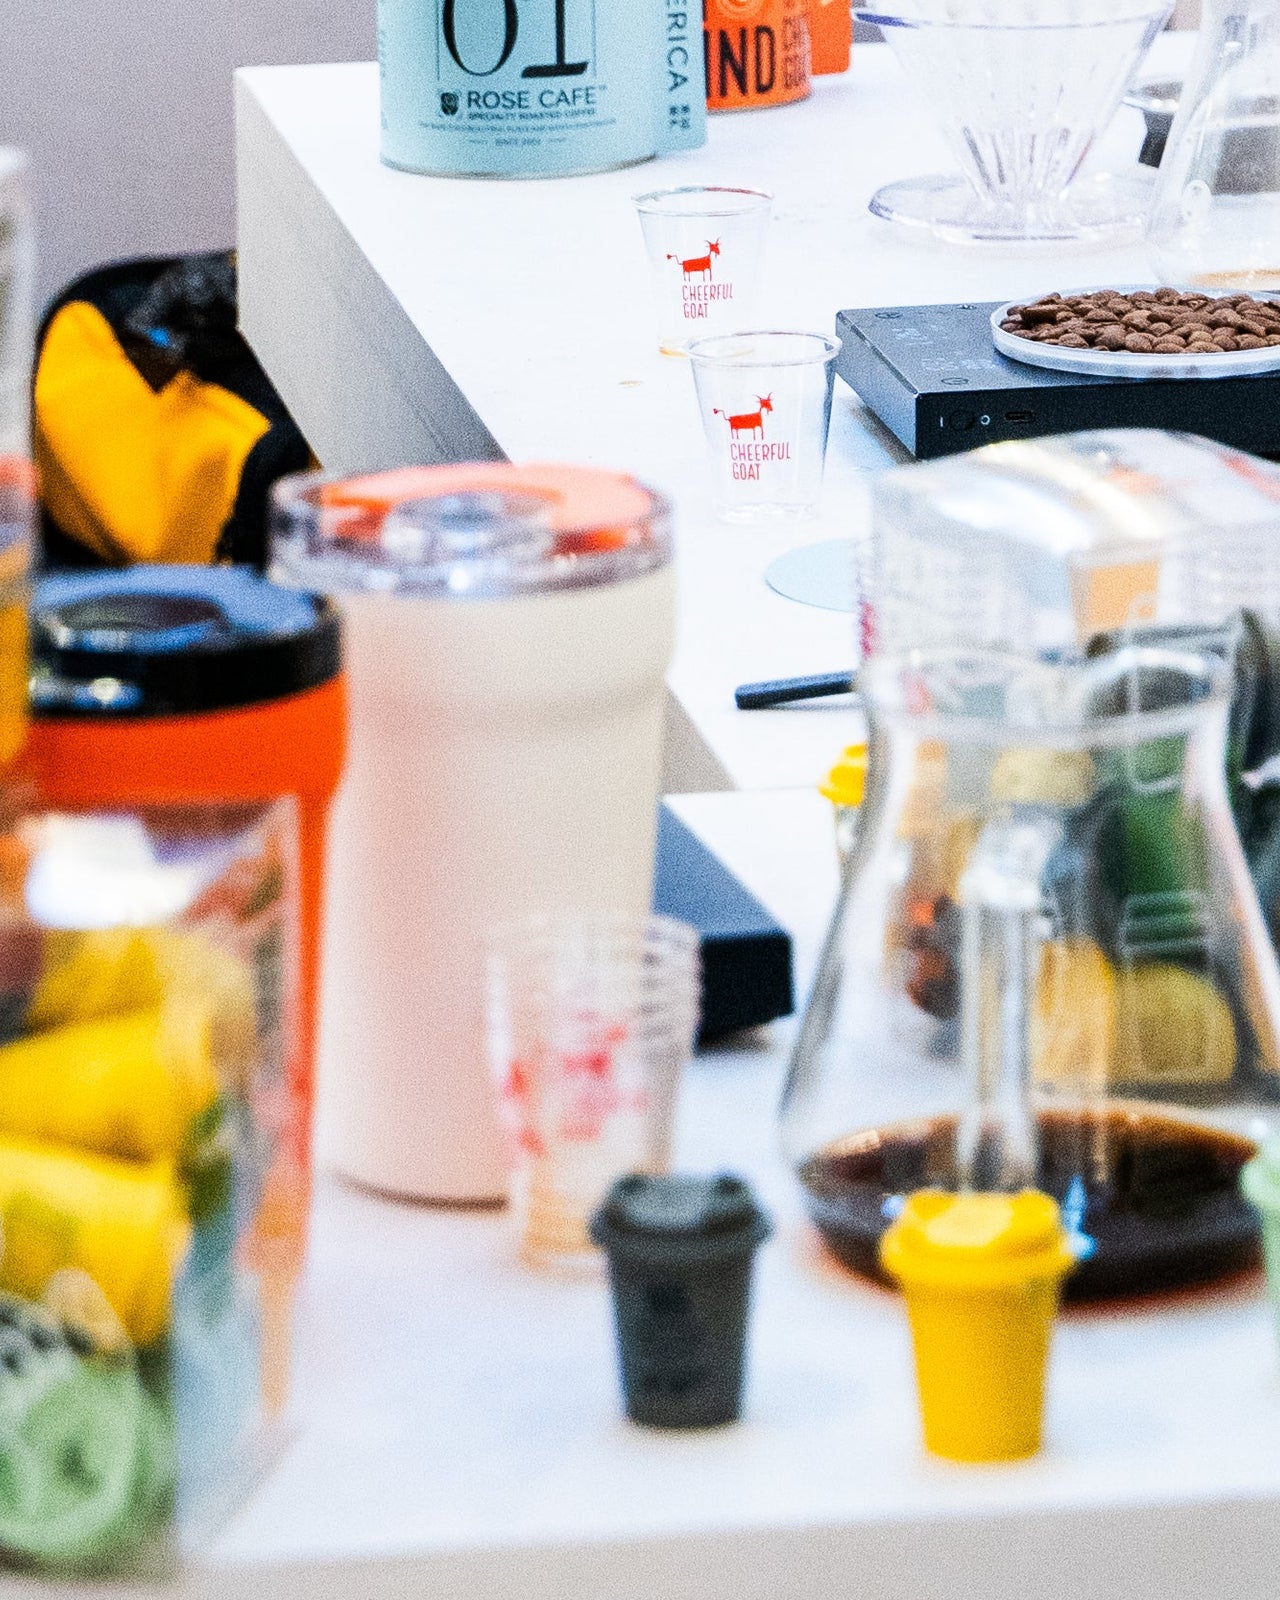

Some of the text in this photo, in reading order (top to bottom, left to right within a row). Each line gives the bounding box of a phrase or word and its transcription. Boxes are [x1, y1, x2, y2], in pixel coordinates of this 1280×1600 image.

[467, 90, 530, 110] ROSE
[682, 283, 733, 301] CHEERFUL
[683, 302, 710, 319] GOAT
[730, 441, 791, 462] CHEERFUL
[732, 463, 761, 481] GOAT
